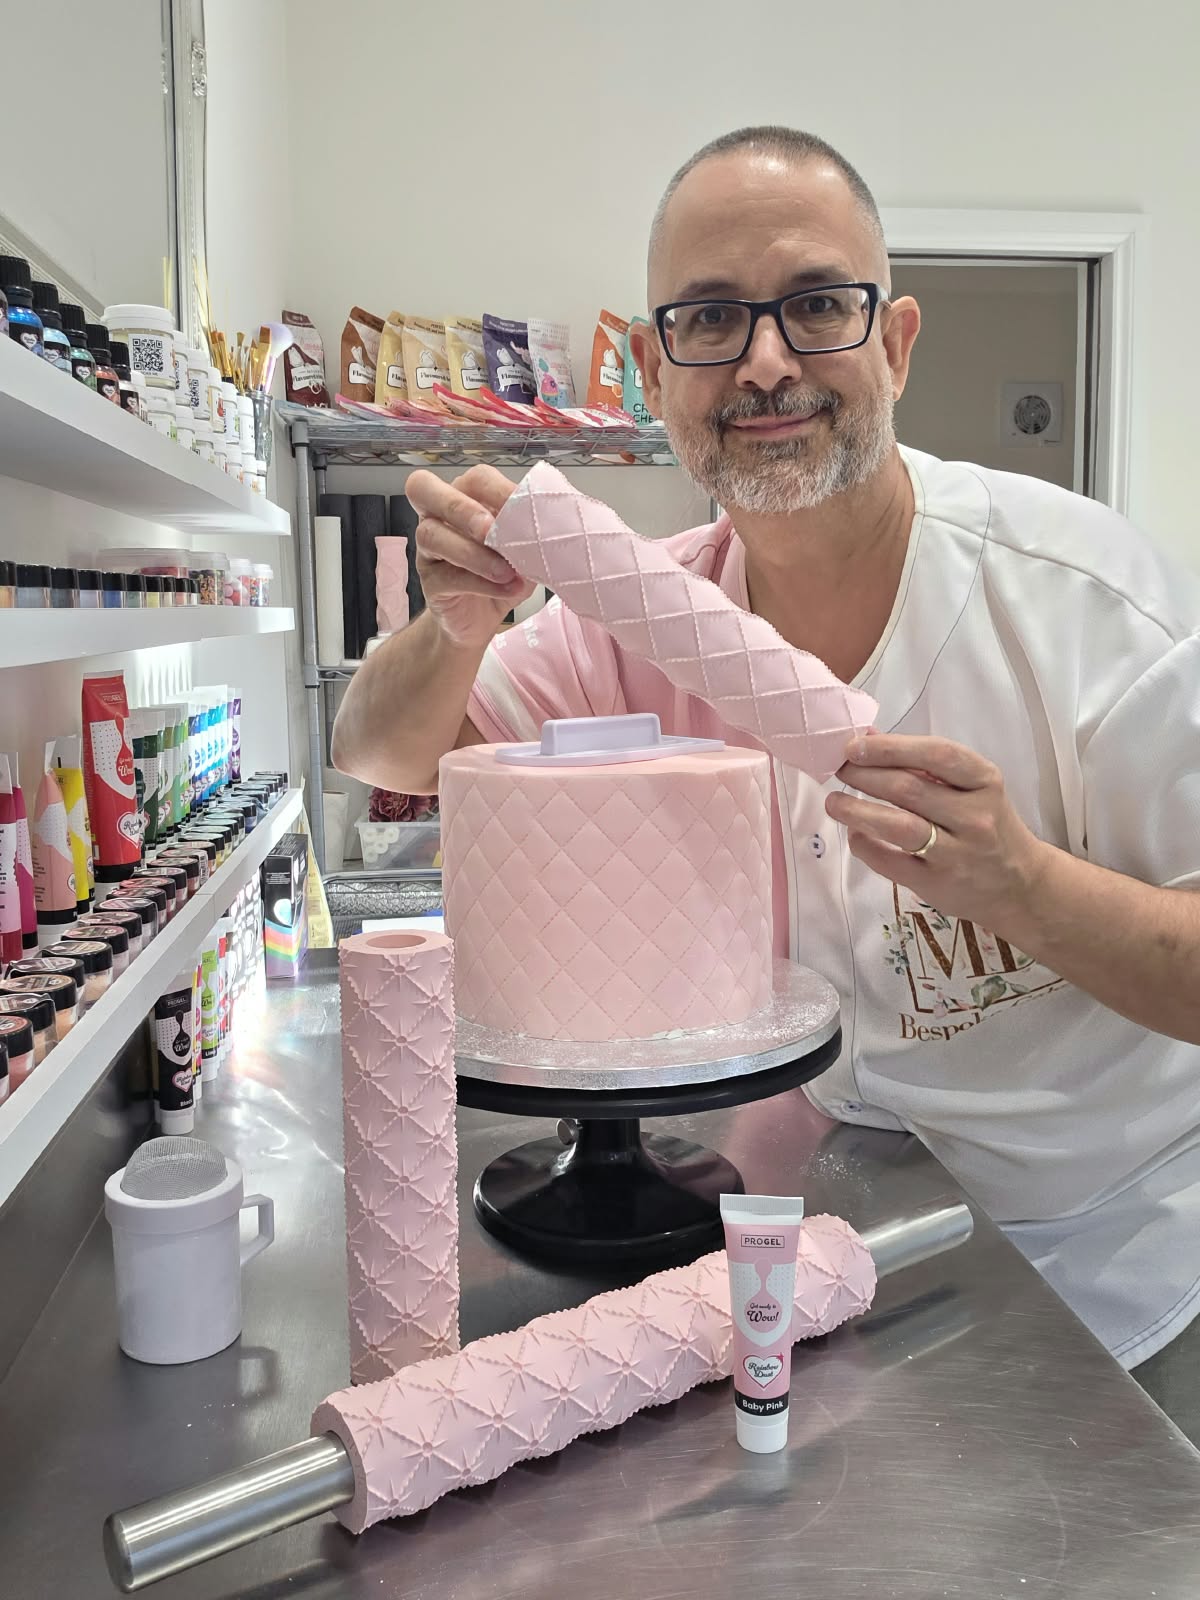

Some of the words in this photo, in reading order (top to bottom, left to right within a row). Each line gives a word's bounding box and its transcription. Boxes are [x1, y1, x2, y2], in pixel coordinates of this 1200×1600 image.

[744, 1237, 781, 1246] PROGEL
[746, 1310, 780, 1322] Wow!
[747, 1362, 779, 1373] Rainbow
[742, 1399, 764, 1412] Baby
[766, 1401, 784, 1411] Pink
